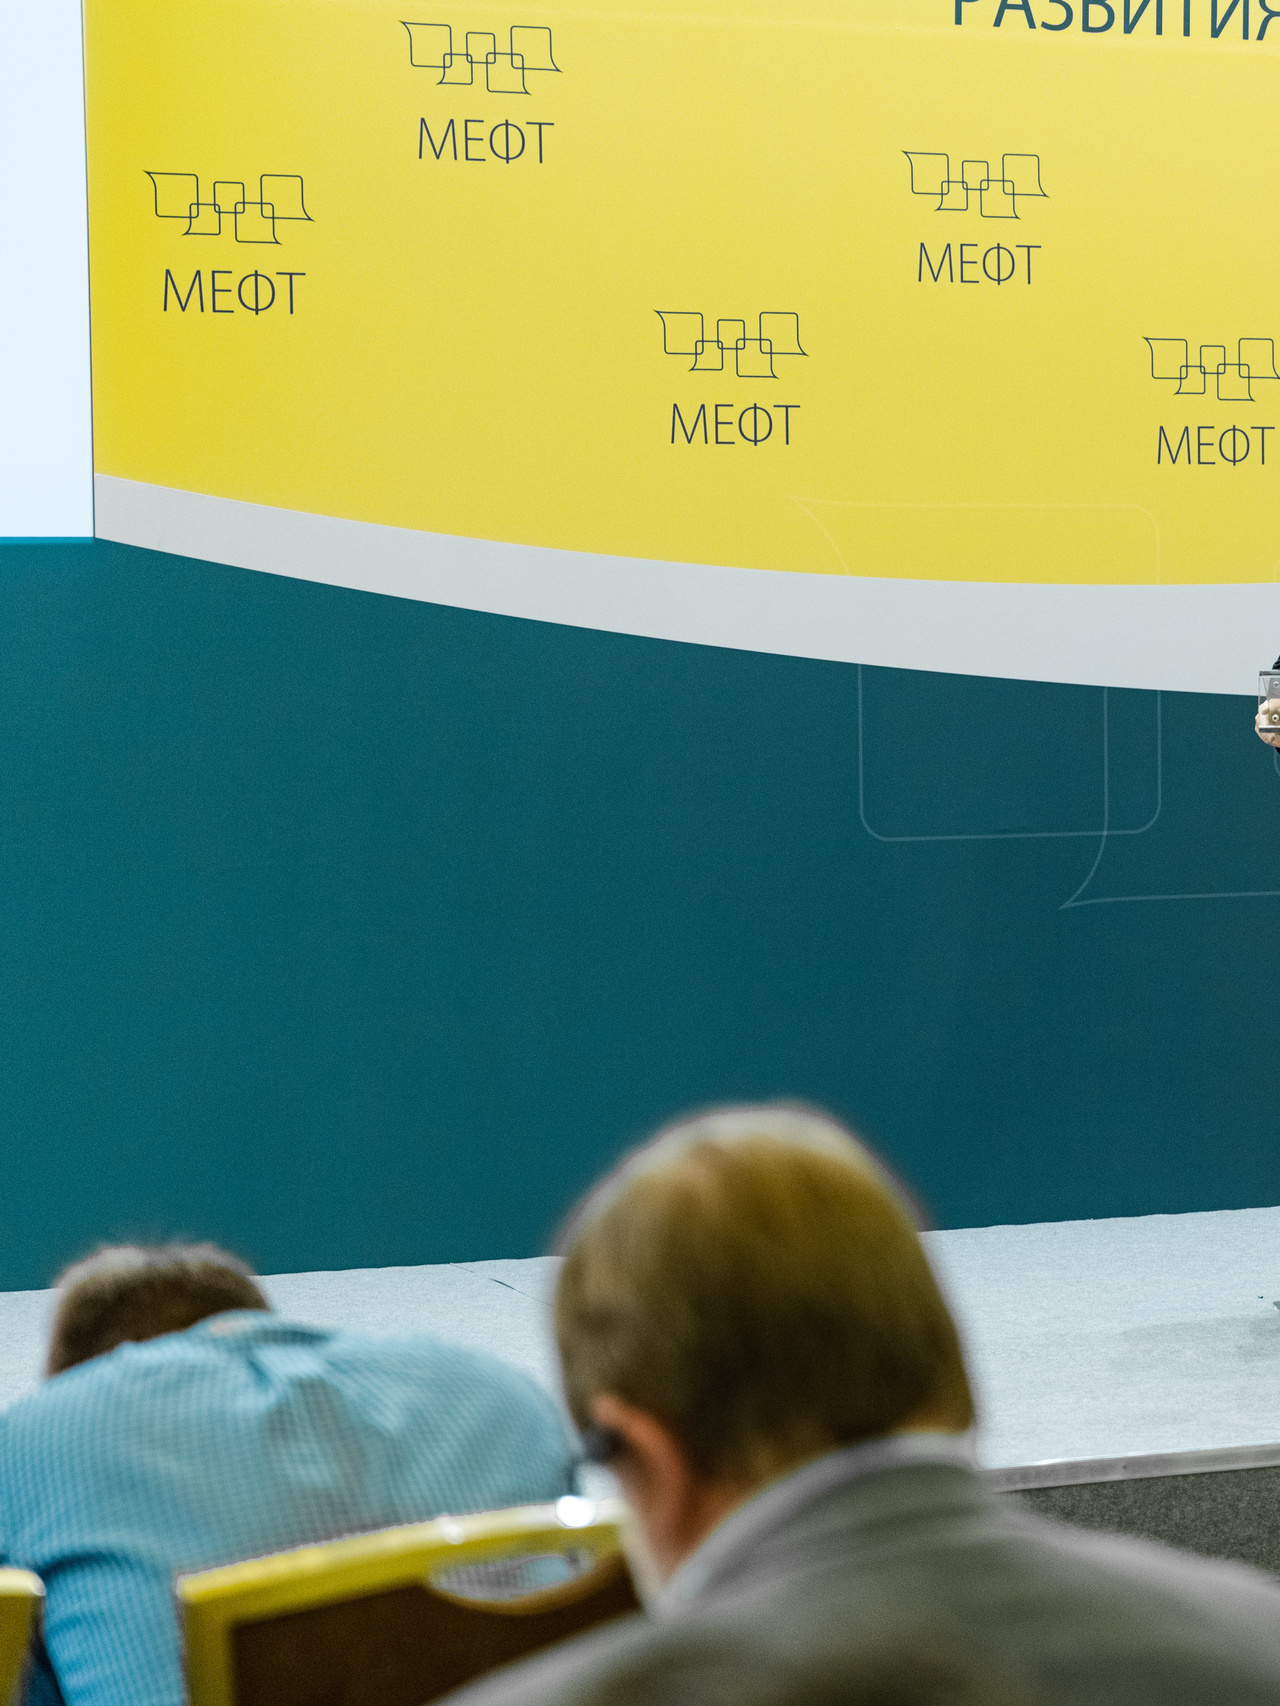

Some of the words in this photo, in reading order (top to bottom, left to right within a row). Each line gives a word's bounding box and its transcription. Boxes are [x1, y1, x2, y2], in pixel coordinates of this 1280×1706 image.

[419, 116, 555, 165] МЕФТ
[917, 241, 1042, 286] МЕФТ
[163, 268, 307, 316] МЕФТ
[670, 402, 801, 447] МЕФТ
[1157, 424, 1276, 467] МЕФТ
